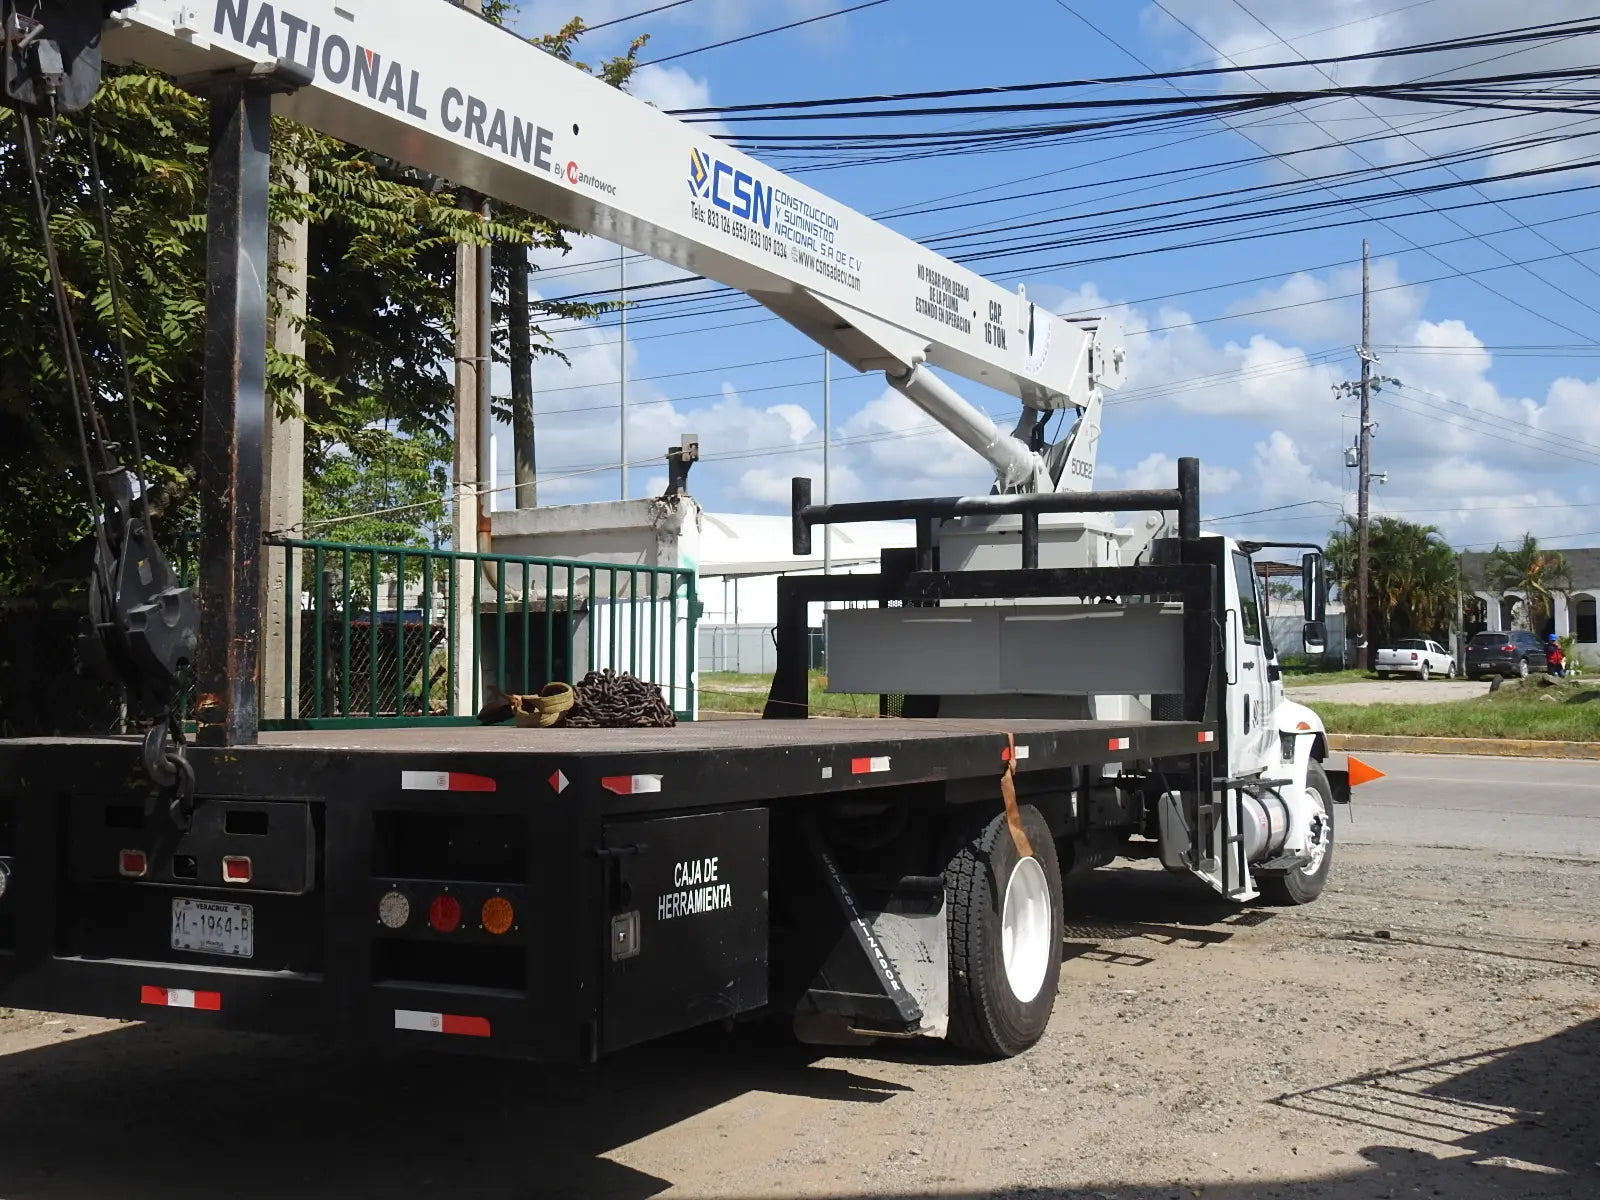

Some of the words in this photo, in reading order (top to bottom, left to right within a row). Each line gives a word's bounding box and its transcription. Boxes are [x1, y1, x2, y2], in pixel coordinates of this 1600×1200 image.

[213, 0, 427, 121] NATIONAL
[440, 86, 554, 172] CRANE
[554, 163, 565, 179] By
[567, 161, 616, 196] Manitowoc
[712, 159, 773, 229] CSN
[707, 208, 720, 230] 833
[774, 188, 839, 231] CONSTRUCCION
[775, 205, 781, 219] Y
[784, 210, 834, 244] SUMINISTRO
[774, 221, 818, 252] NACIONAL
[836, 251, 847, 266] DE
[917, 264, 925, 281] NO
[926, 268, 941, 289] PASAR
[942, 275, 952, 295] POR
[952, 279, 970, 303] DEBAJO
[929, 286, 936, 301] DE
[936, 290, 942, 305] LA
[942, 292, 959, 313] PLUMA
[915, 296, 937, 319] ESTANDO
[945, 309, 971, 335] OPERACION
[984, 322, 992, 345] 16
[674, 860, 702, 888] CAJA
[704, 857, 719, 883] DE
[196, 903, 229, 913] VERACRUZ
[658, 883, 732, 921] HERRAMIENTA
